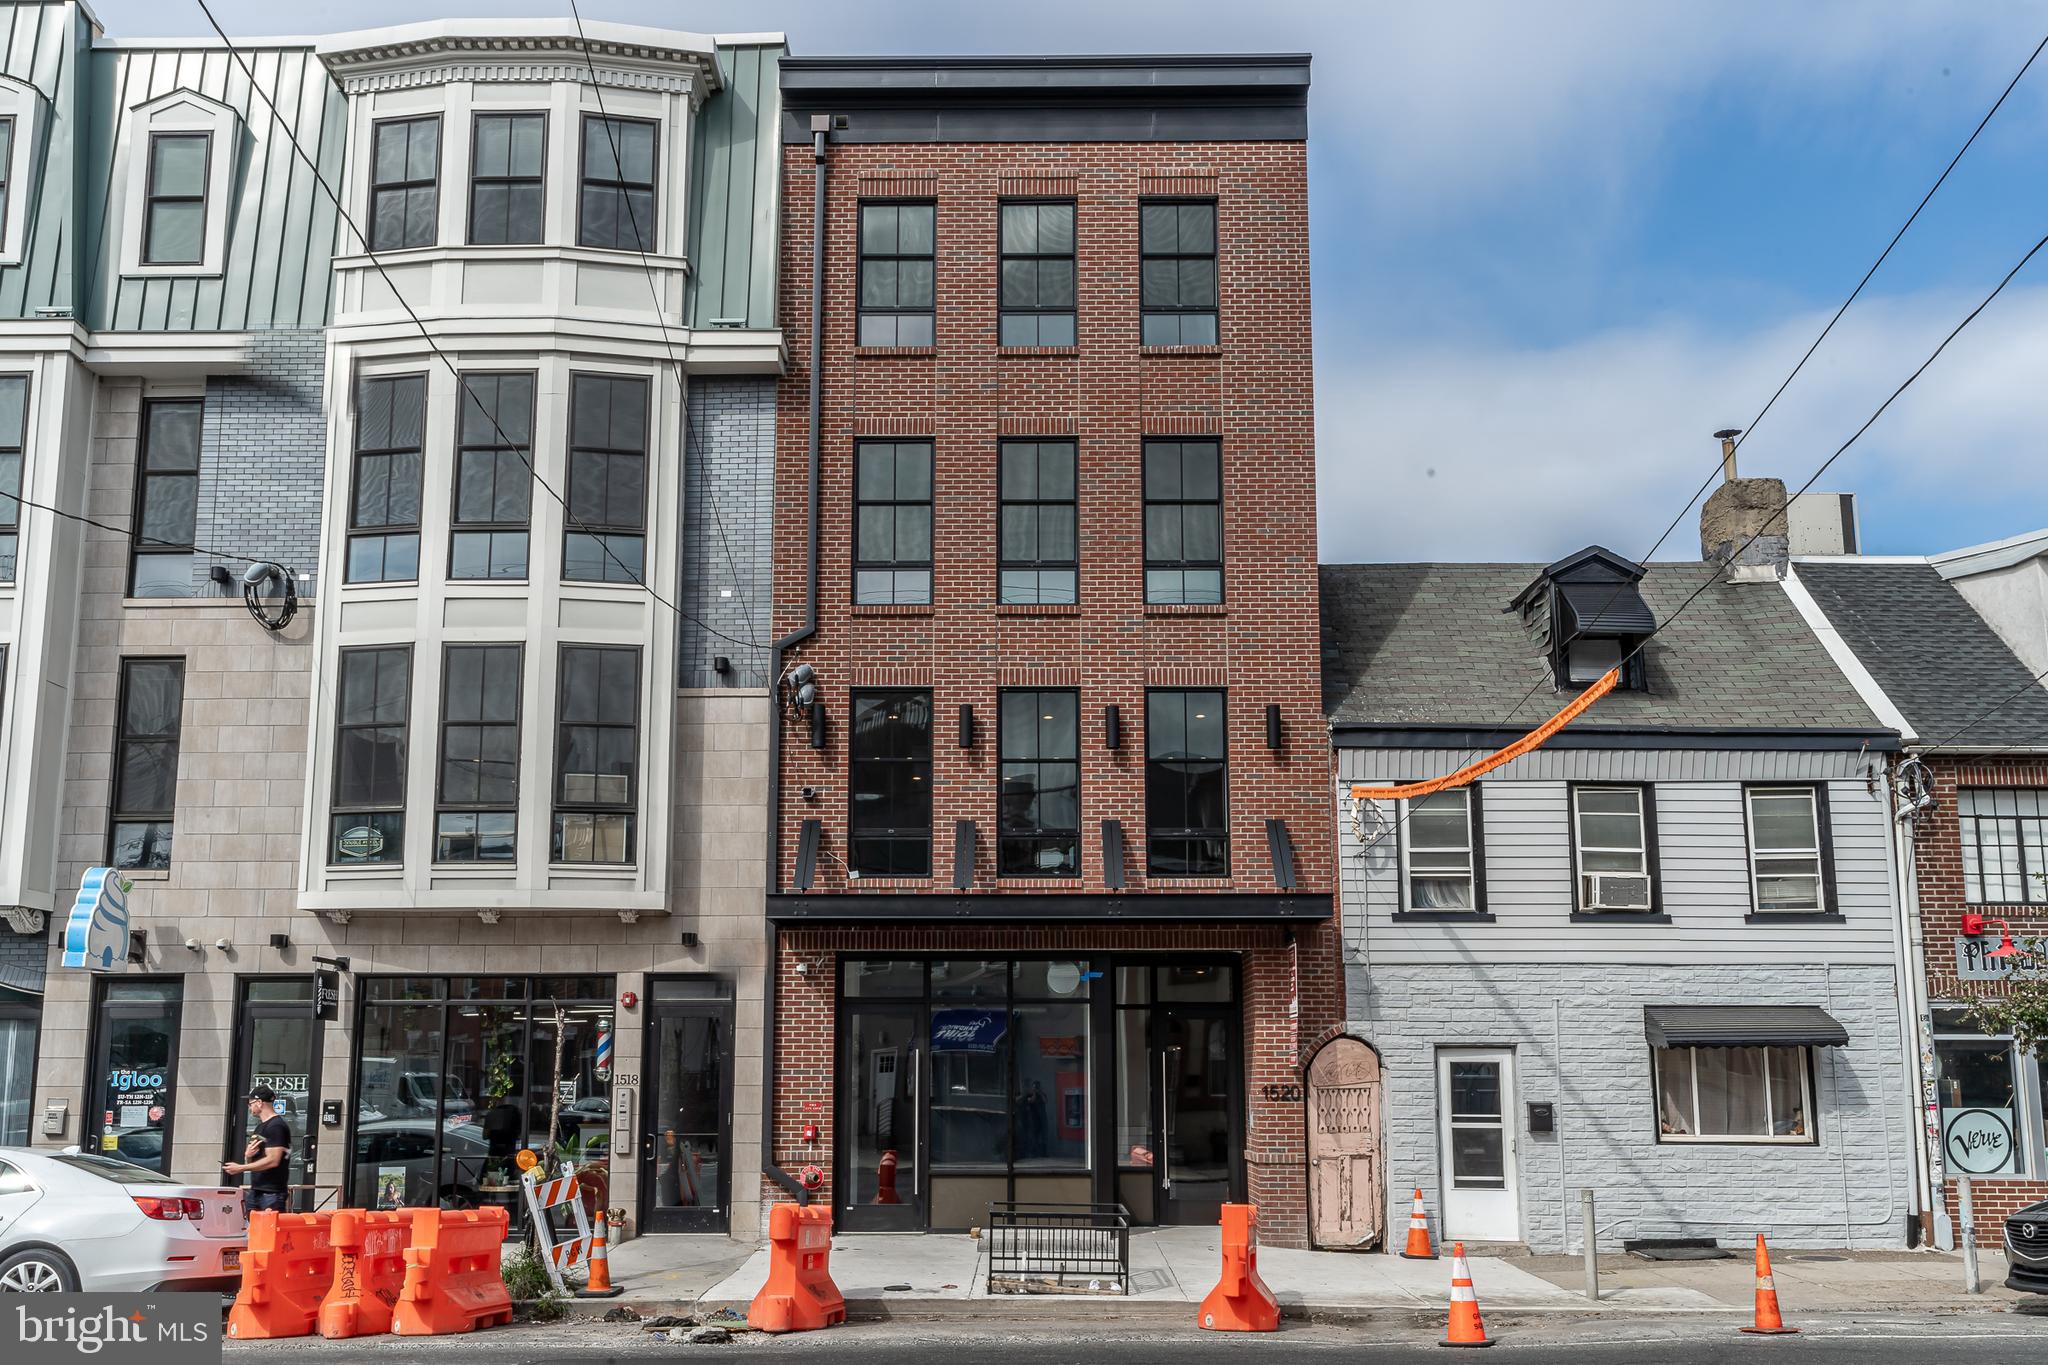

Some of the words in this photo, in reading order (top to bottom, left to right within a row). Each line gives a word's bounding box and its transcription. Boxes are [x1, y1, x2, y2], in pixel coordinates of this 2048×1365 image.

[111, 1071, 162, 1091] Igloo
[255, 1076, 307, 1091] FRESH
[614, 1074, 639, 1085] 1518
[1262, 1084, 1301, 1102] 1520
[1952, 1129, 2004, 1159] Verve
